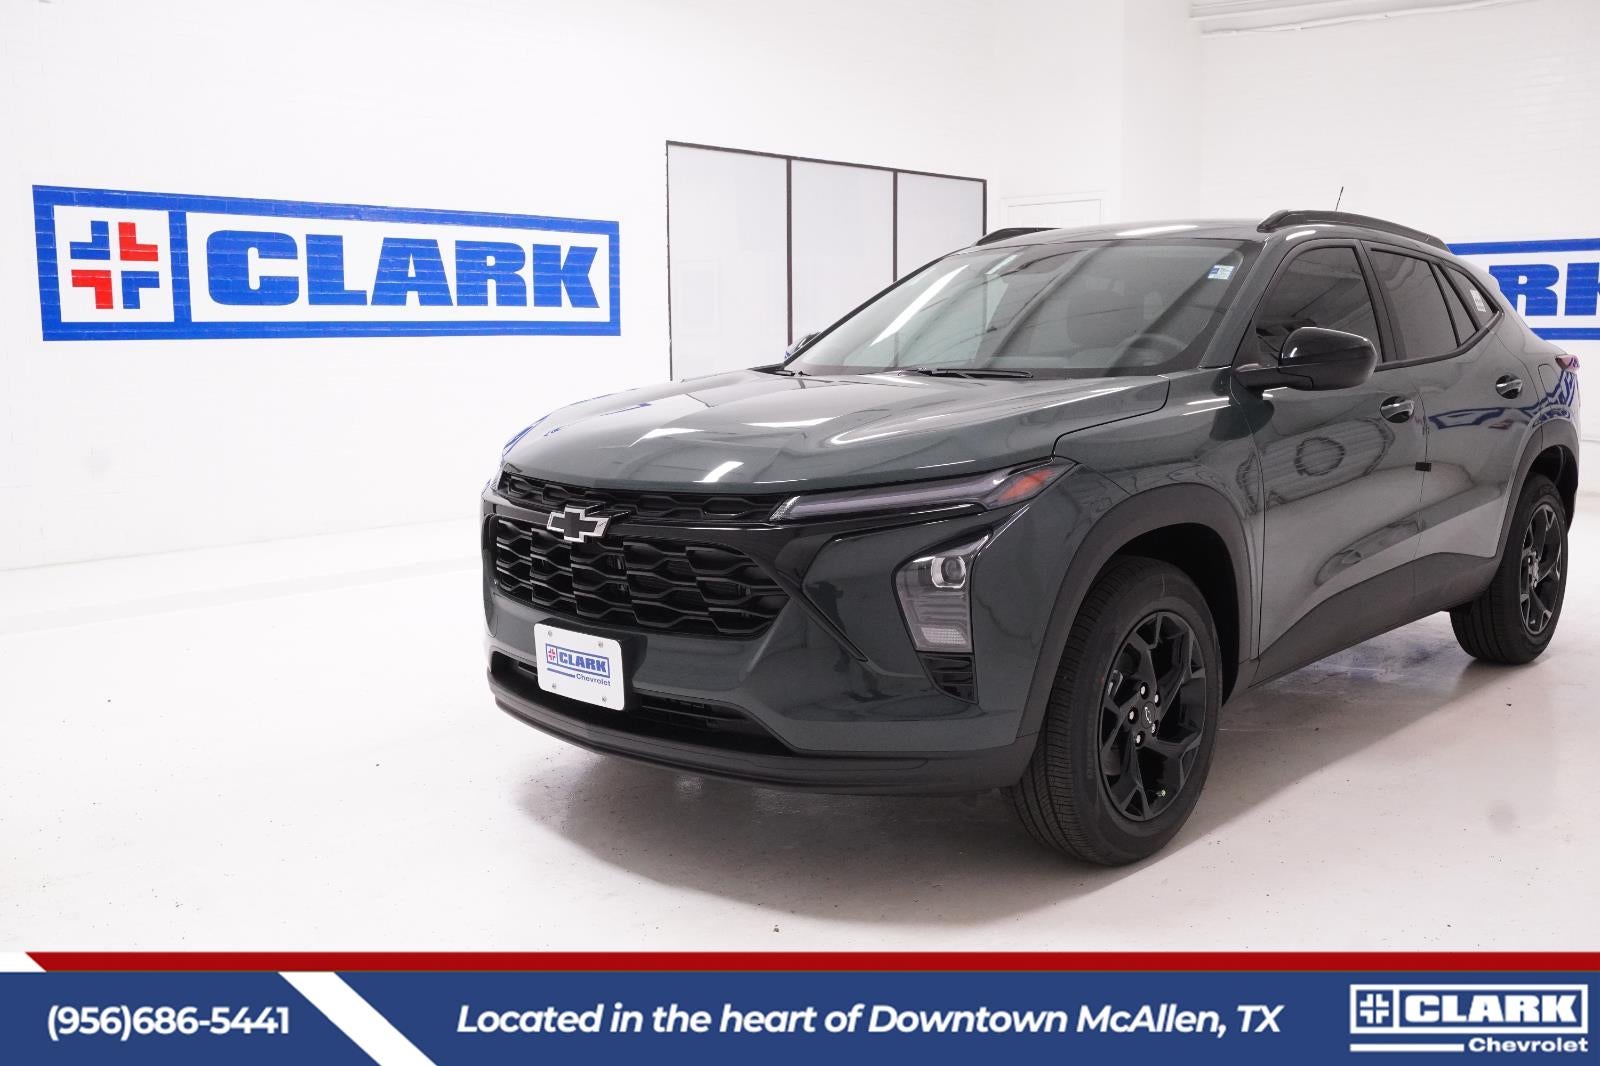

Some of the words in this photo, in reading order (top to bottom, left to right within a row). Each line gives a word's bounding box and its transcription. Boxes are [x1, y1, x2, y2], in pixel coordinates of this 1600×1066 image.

[206, 229, 600, 308] CLARK
[559, 651, 607, 673] CLARK
[576, 673, 611, 687] Chevrolet
